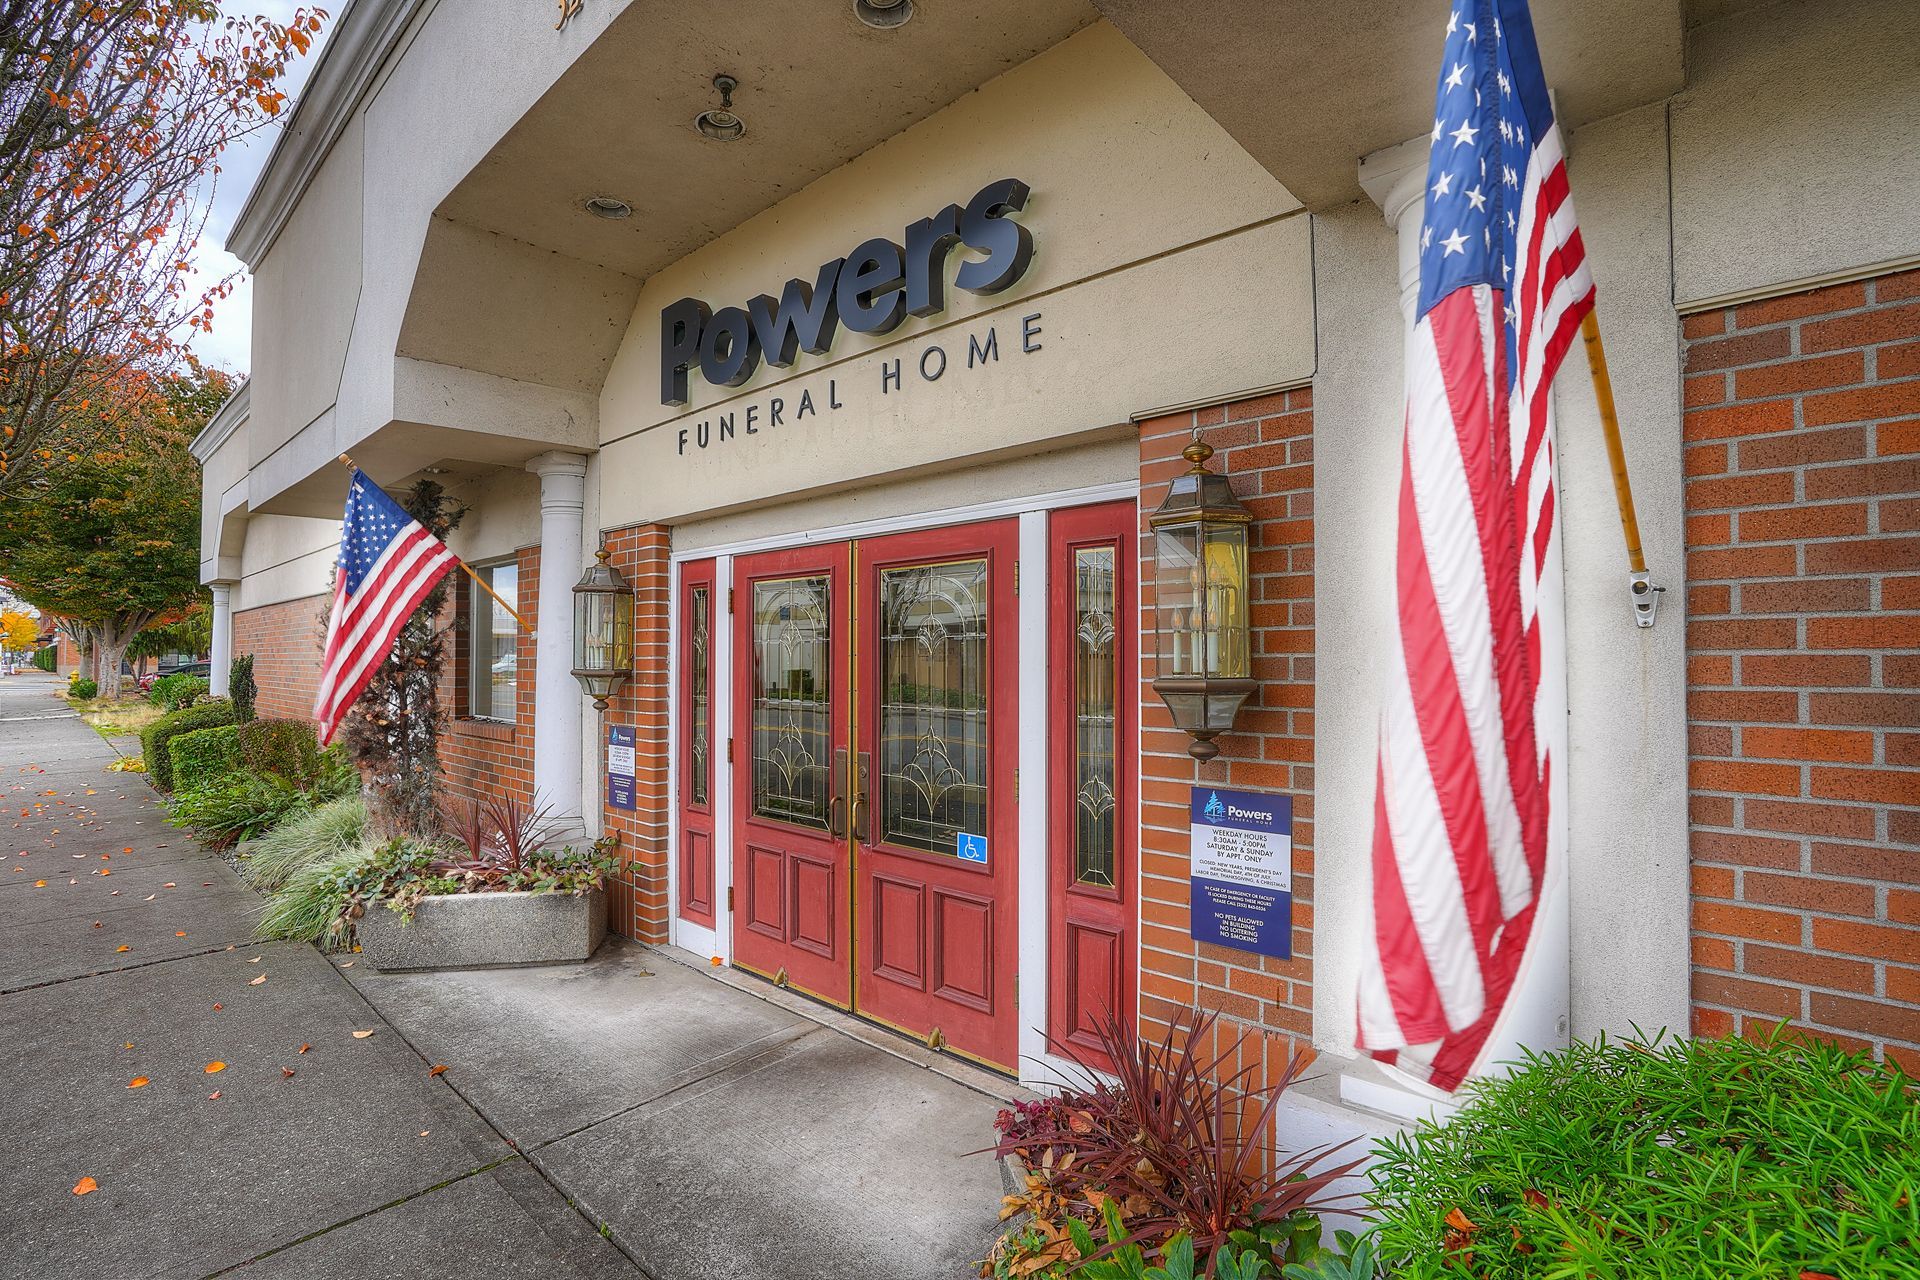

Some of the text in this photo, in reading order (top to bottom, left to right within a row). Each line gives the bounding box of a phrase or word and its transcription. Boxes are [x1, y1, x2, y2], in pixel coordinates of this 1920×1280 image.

[660, 178, 1033, 406] Powers
[678, 313, 1041, 455] FUNERAL HOME
[1228, 806, 1272, 820] Powers
[1212, 829, 1242, 838] WEEKDAY
[1214, 836, 1237, 844] 8:30AM
[1207, 842, 1238, 852] SATURDAY
[1247, 848, 1273, 857] SUNDAY
[1244, 855, 1262, 863] ONLY
[1227, 890, 1251, 898] EMERGENCY
[1230, 921, 1255, 930] BUILDING
[1238, 917, 1263, 926] ALLOWED
[1230, 927, 1258, 937] LOITERING
[1231, 933, 1257, 943] SMOKING
